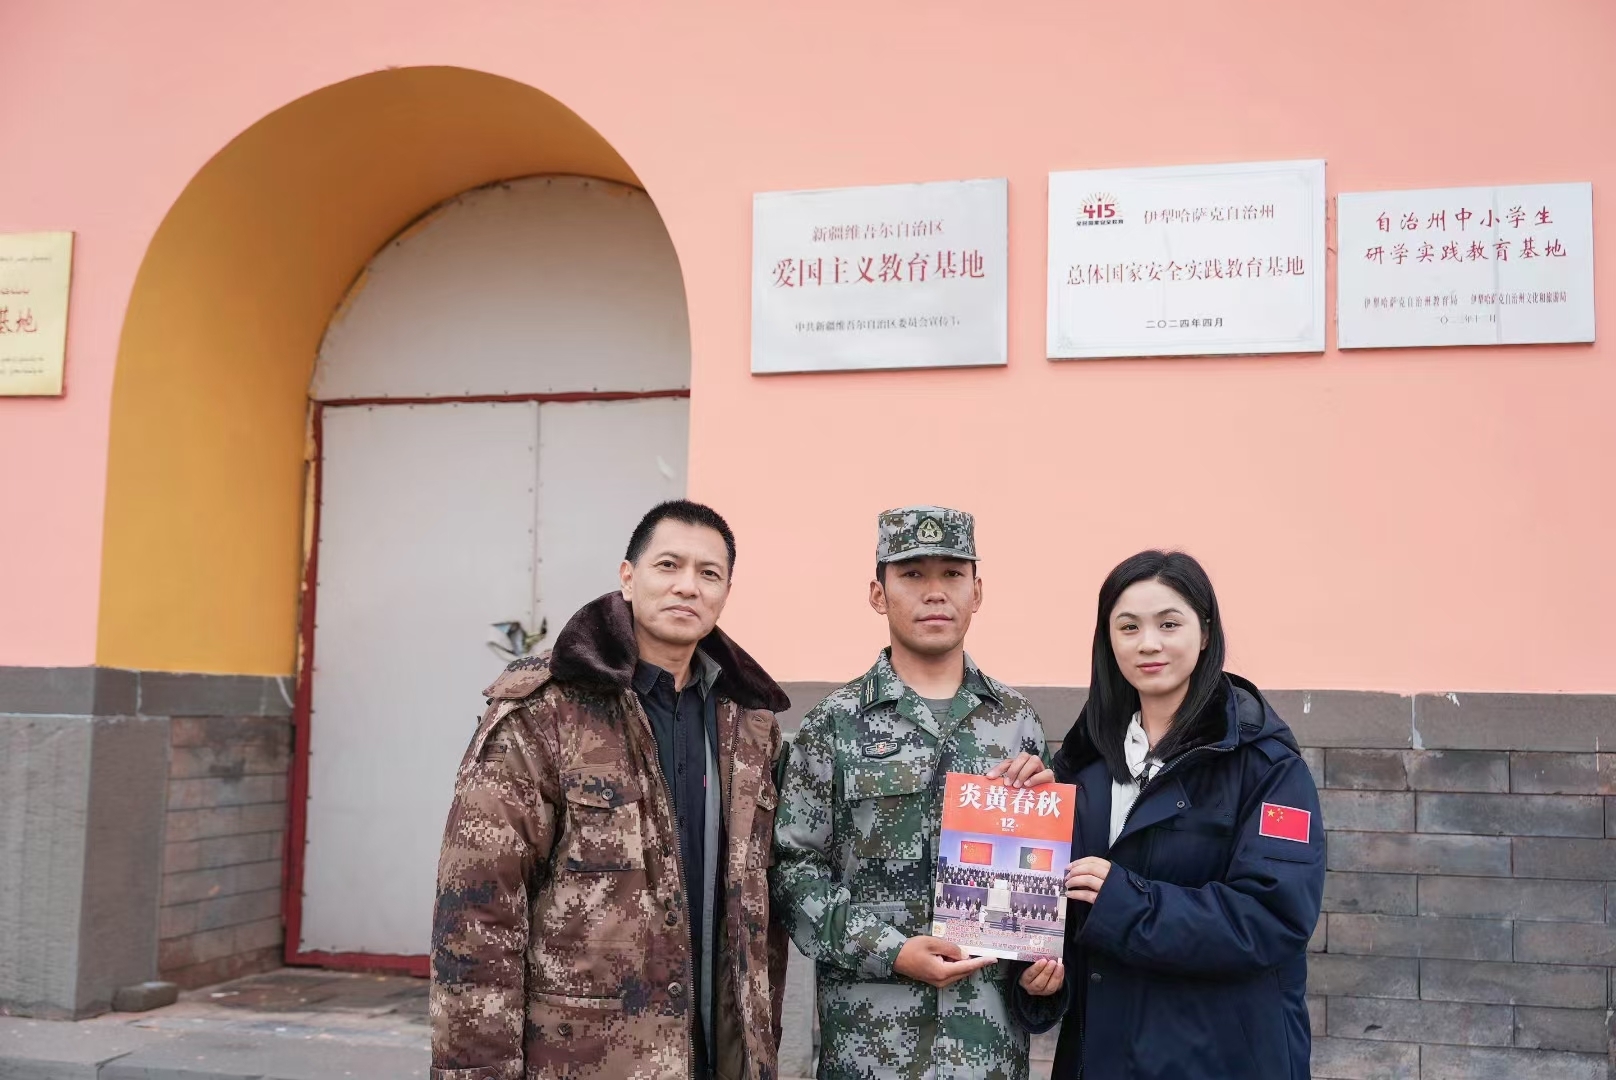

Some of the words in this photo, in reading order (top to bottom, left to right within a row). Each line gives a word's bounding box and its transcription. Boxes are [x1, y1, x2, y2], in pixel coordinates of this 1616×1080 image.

[1083, 203, 1116, 219] 415
[1144, 204, 1274, 225] 伊犁哈萨克自治州
[1376, 205, 1554, 233] 自治州中小学生
[812, 219, 945, 243] 新疆维吾尔自治区
[1365, 236, 1567, 266] 研学实践教育基地
[772, 249, 985, 289] 爱国主义教育基地
[1067, 255, 1305, 286] 总体国家安全实践教育基地
[1145, 317, 1223, 329] 二〇二四年四月
[957, 782, 1063, 818] 炎黄春秋
[1000, 817, 1015, 828] 12
